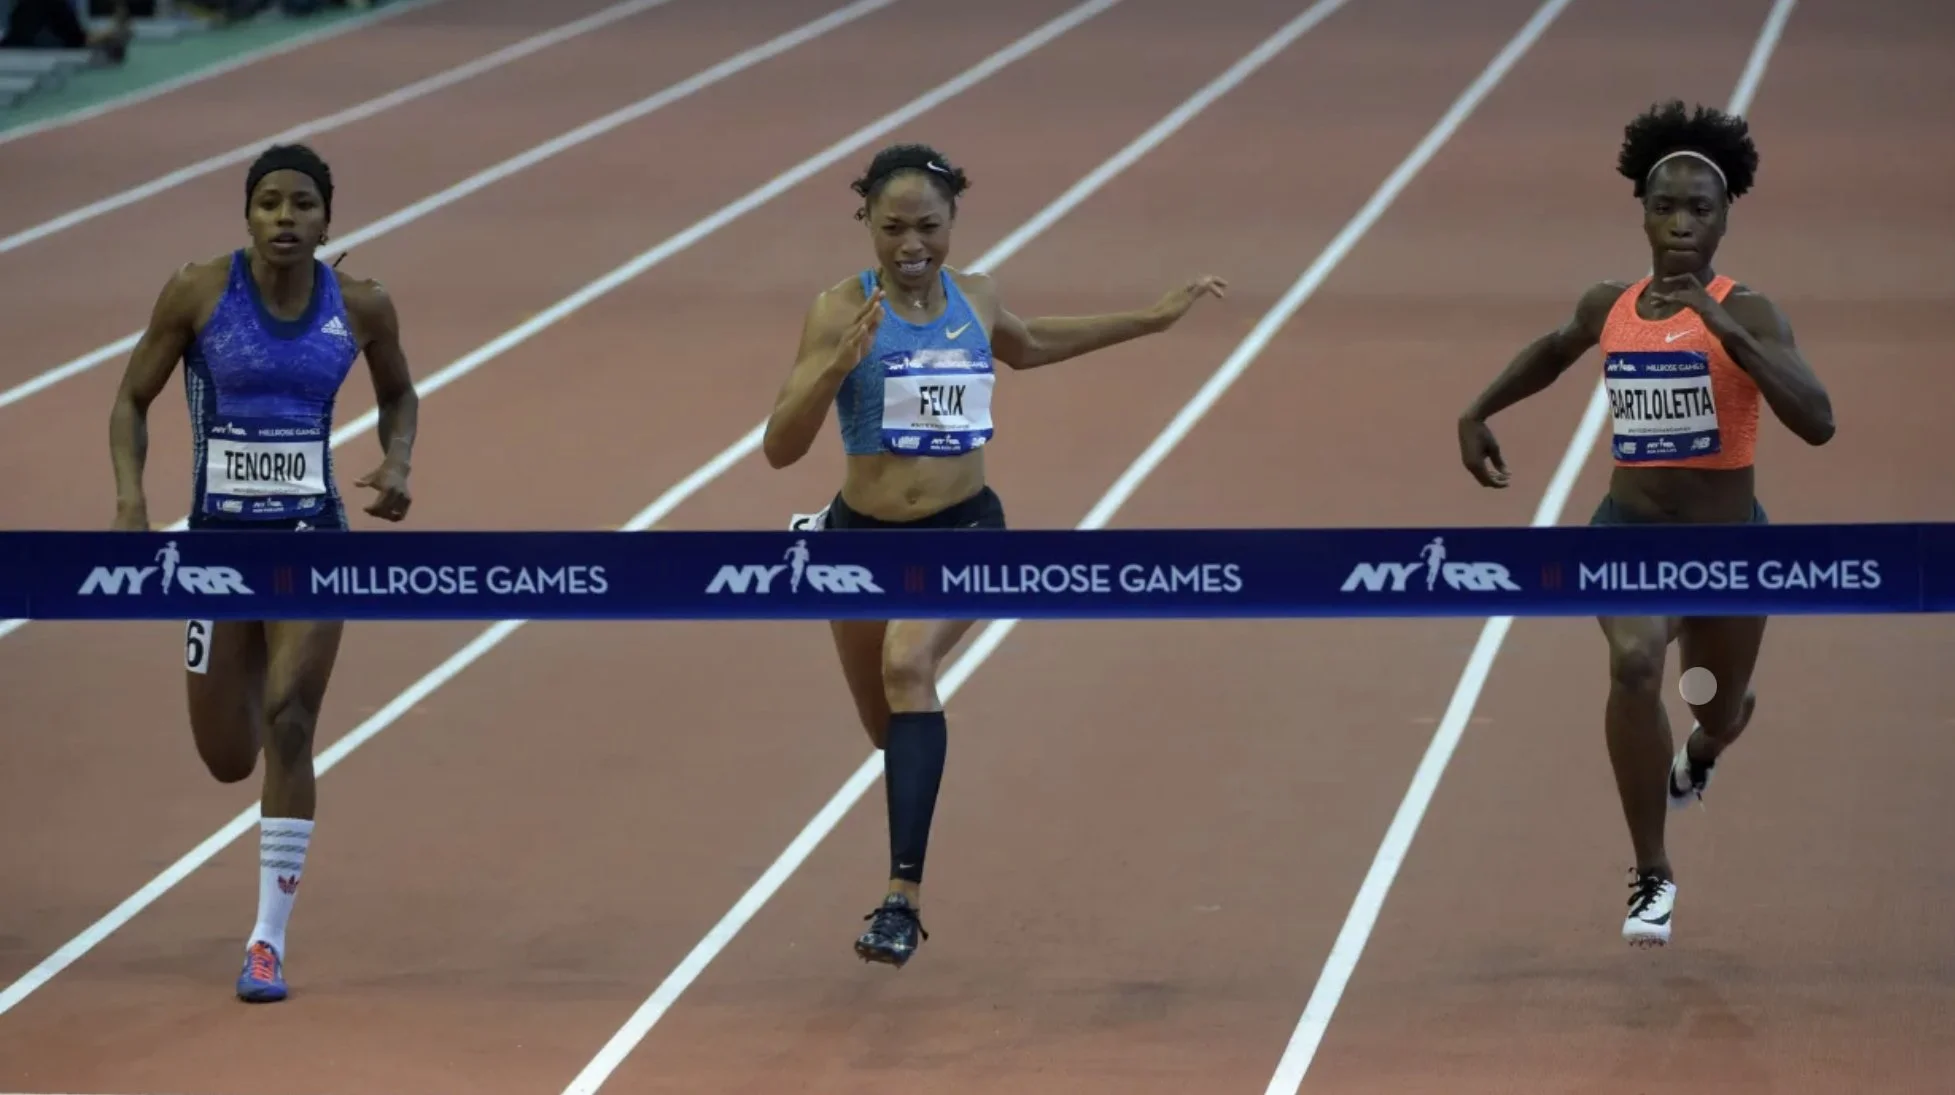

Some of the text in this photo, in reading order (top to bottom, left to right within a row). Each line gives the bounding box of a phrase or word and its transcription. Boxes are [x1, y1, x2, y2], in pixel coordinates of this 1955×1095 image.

[919, 384, 966, 416] FELIX
[1609, 386, 1714, 420] BARTLOLETTA
[224, 450, 306, 481] TENORIO
[311, 566, 608, 595] MILLROSE GAMES
[941, 564, 1243, 594] MILLROSE GAMES
[1579, 560, 1881, 591] MILLROSE GAMES
[187, 620, 205, 668] 6
